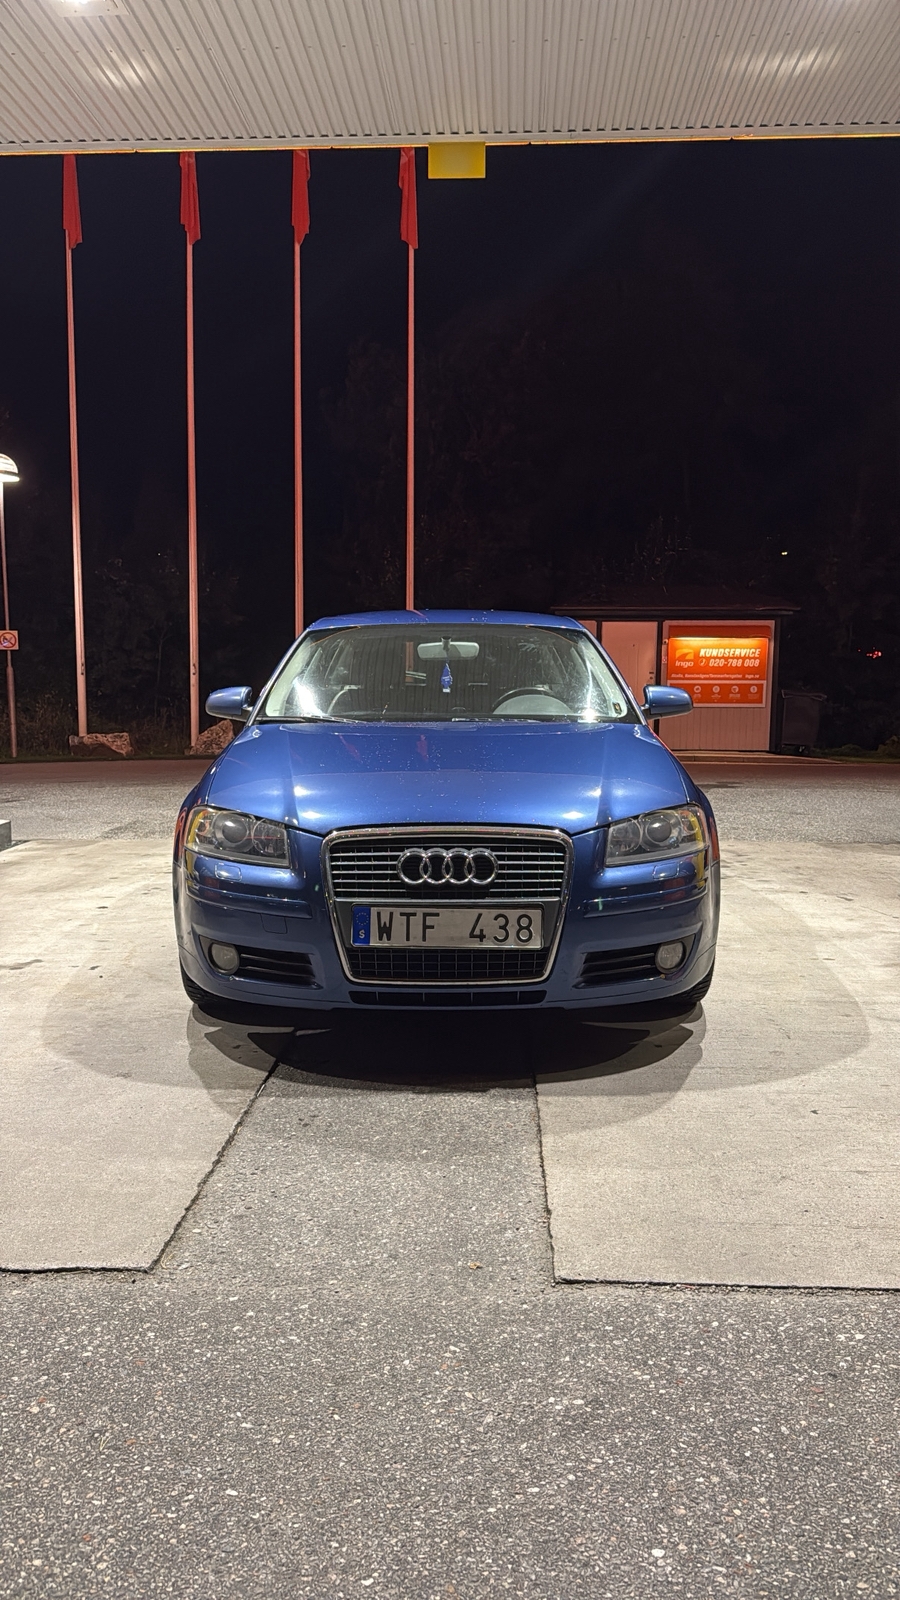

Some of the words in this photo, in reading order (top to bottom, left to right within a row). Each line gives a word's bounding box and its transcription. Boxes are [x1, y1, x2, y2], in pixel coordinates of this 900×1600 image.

[699, 648, 761, 657] KUNDSERVICE
[709, 658, 742, 667] 020-788
[743, 658, 760, 667] 008
[376, 911, 440, 942] WTF
[469, 912, 533, 943] 438
[358, 929, 366, 939] S
